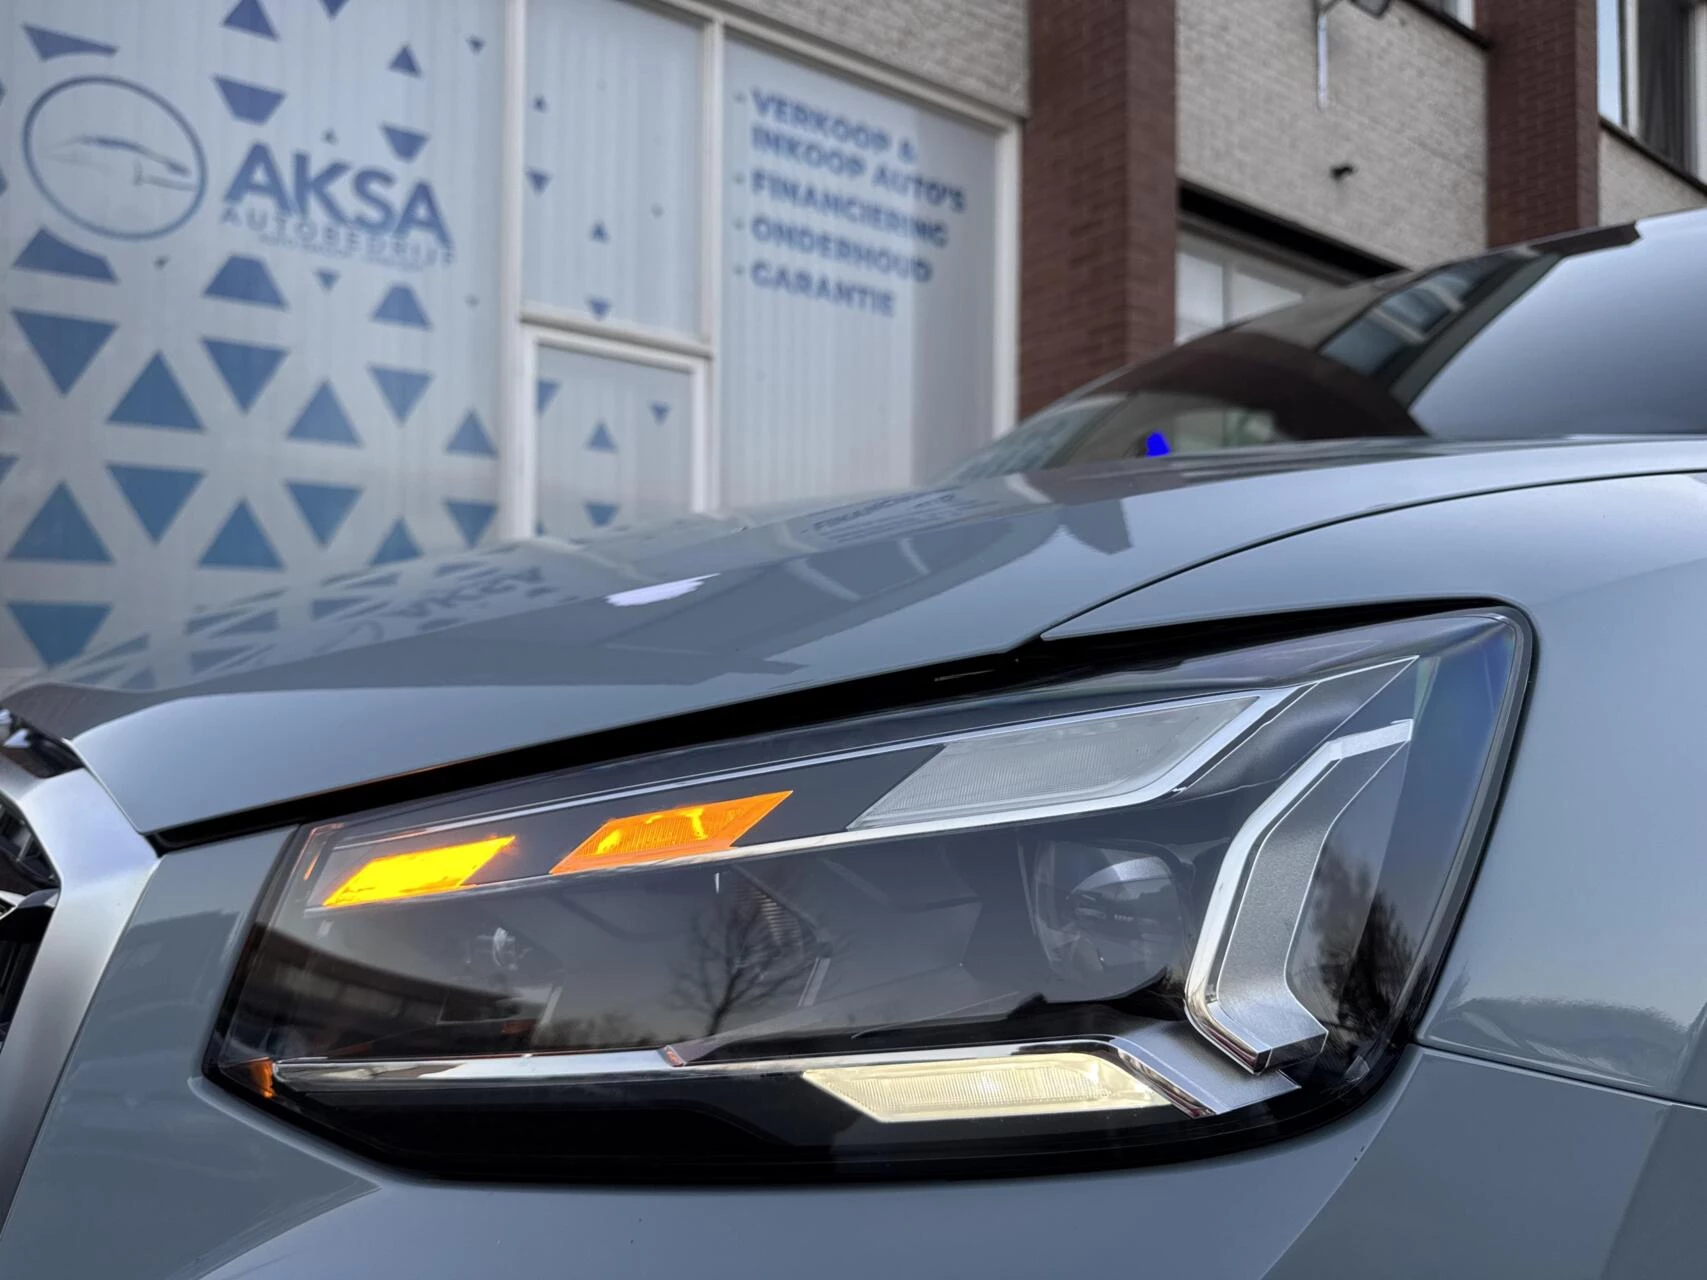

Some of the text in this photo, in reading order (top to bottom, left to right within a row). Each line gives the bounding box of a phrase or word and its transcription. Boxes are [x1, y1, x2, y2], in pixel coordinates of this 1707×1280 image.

[751, 89, 890, 154] VERKOOP
[752, 125, 865, 178] INKOOP
[223, 142, 453, 250] AKSA
[752, 216, 933, 283] ONDERHOUD
[752, 261, 894, 317] GARANTIE
